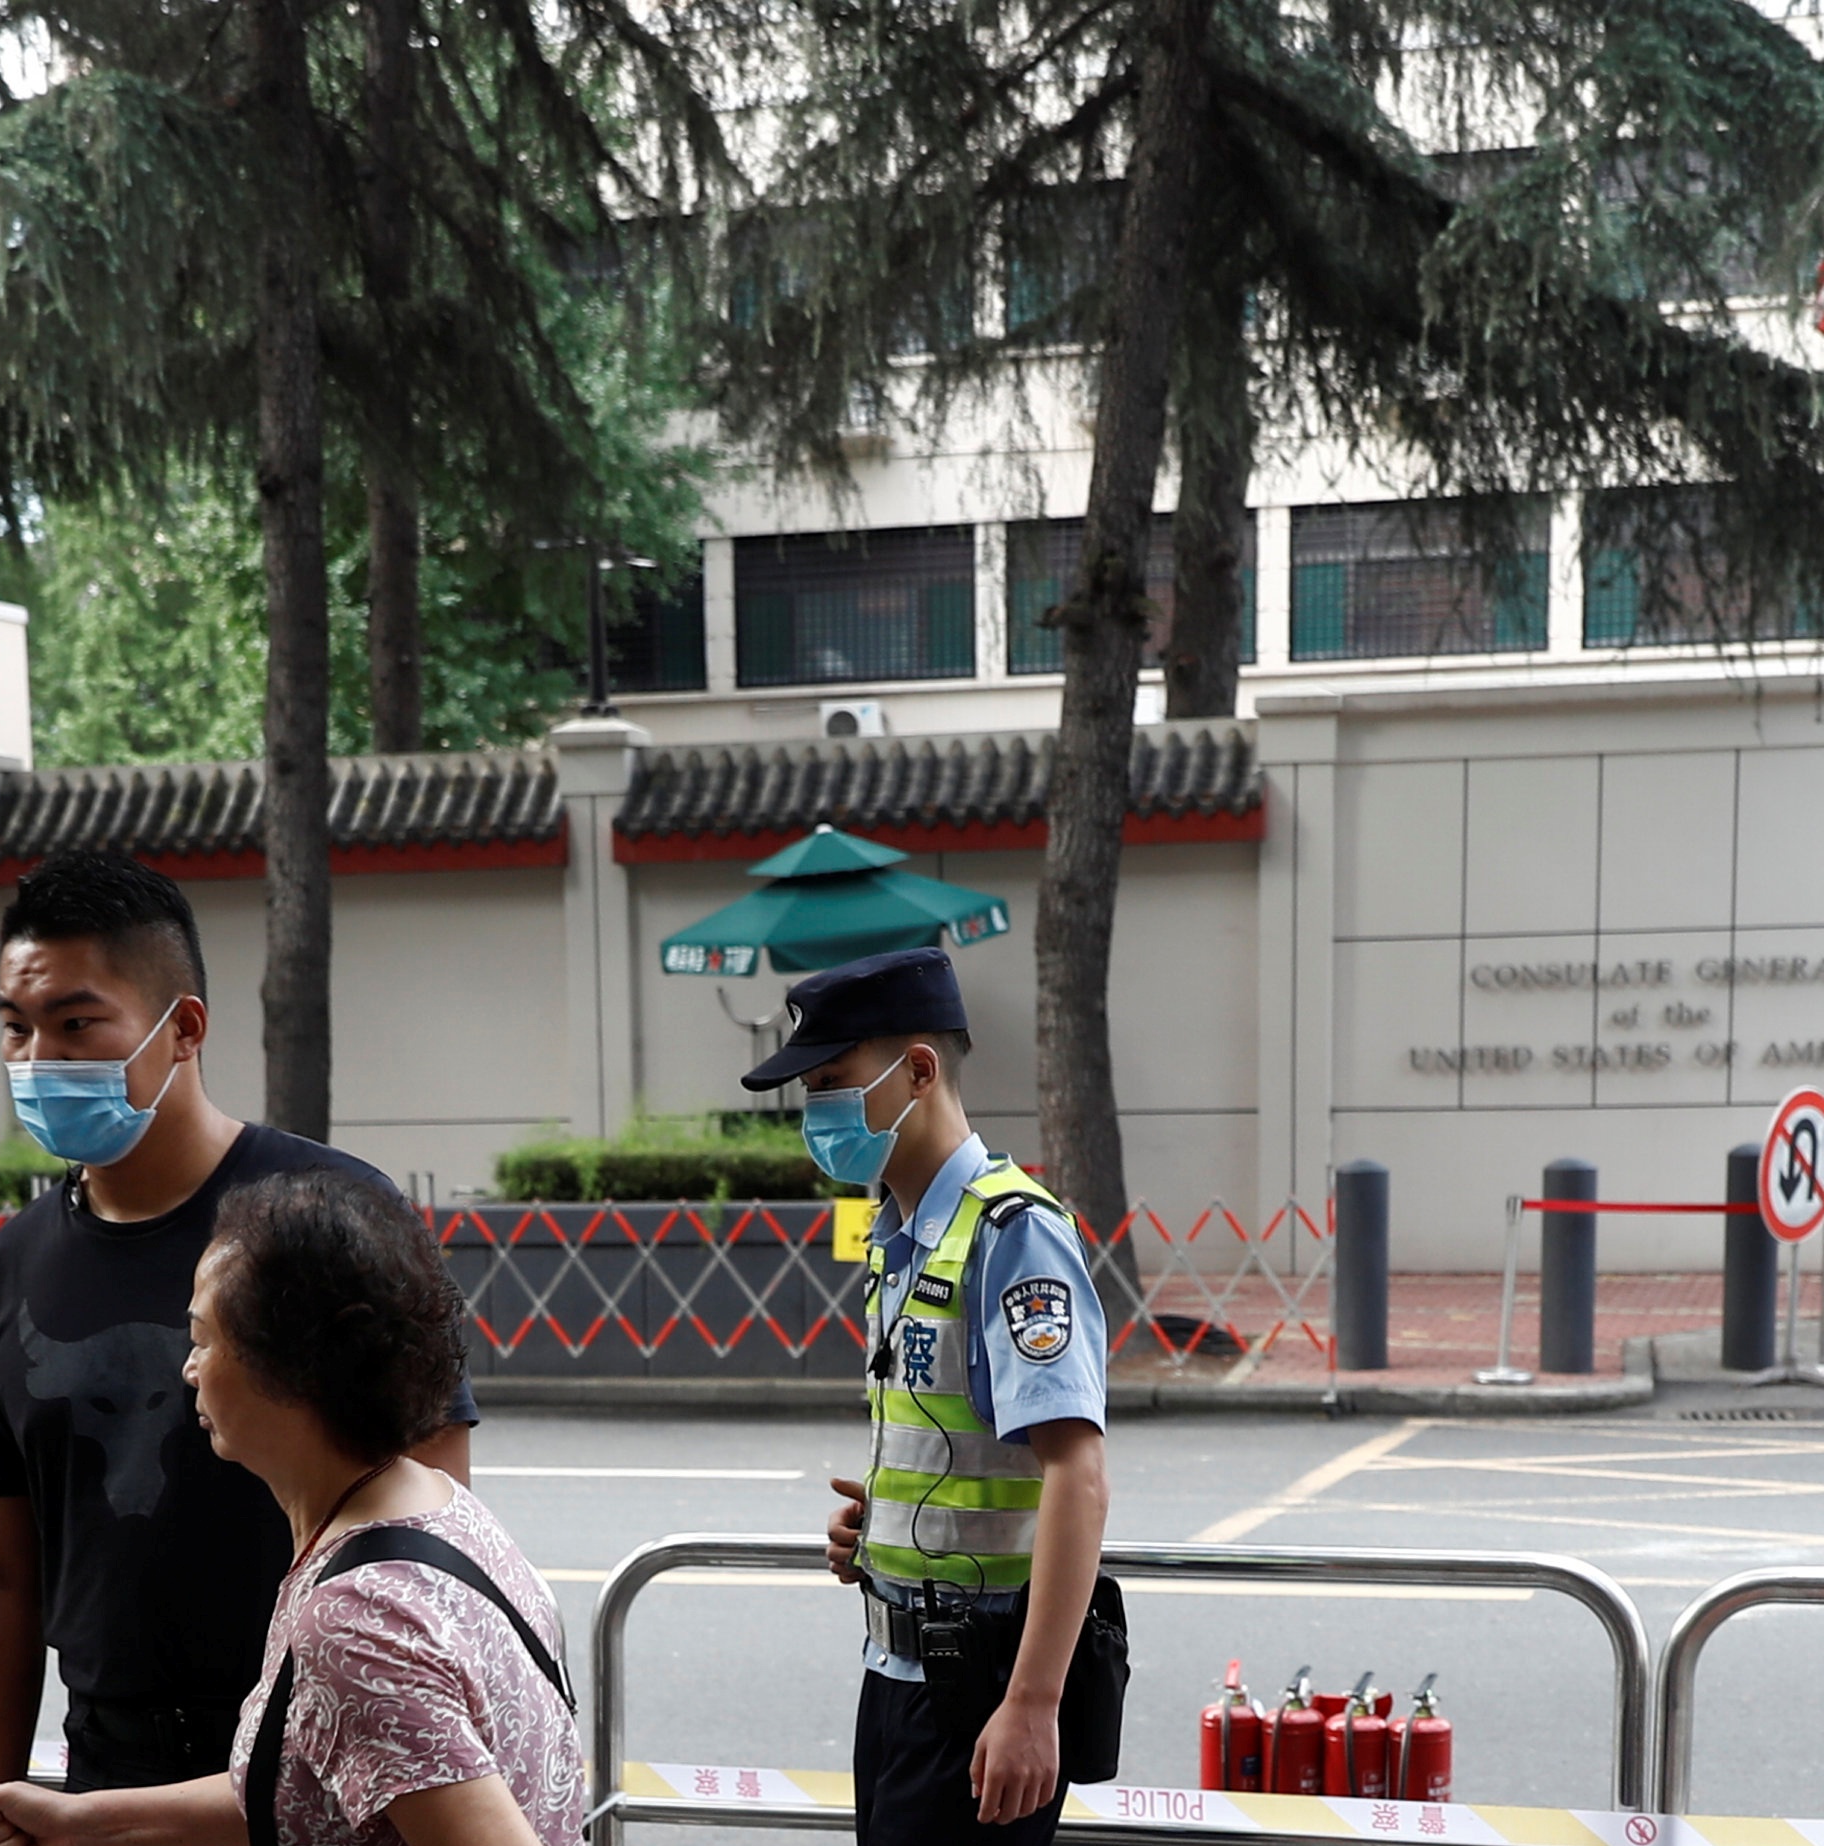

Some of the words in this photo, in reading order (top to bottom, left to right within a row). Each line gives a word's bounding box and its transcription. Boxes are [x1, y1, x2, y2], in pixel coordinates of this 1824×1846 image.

[1470, 960, 1673, 989] CONSULATE
[1611, 1002, 1639, 1027] of
[1663, 1001, 1711, 1027] the
[1410, 1046, 1534, 1073] UNITED
[1552, 1043, 1672, 1069] STATES
[1694, 1041, 1739, 1067] OF
[1115, 1788, 1205, 1822] POLICE
